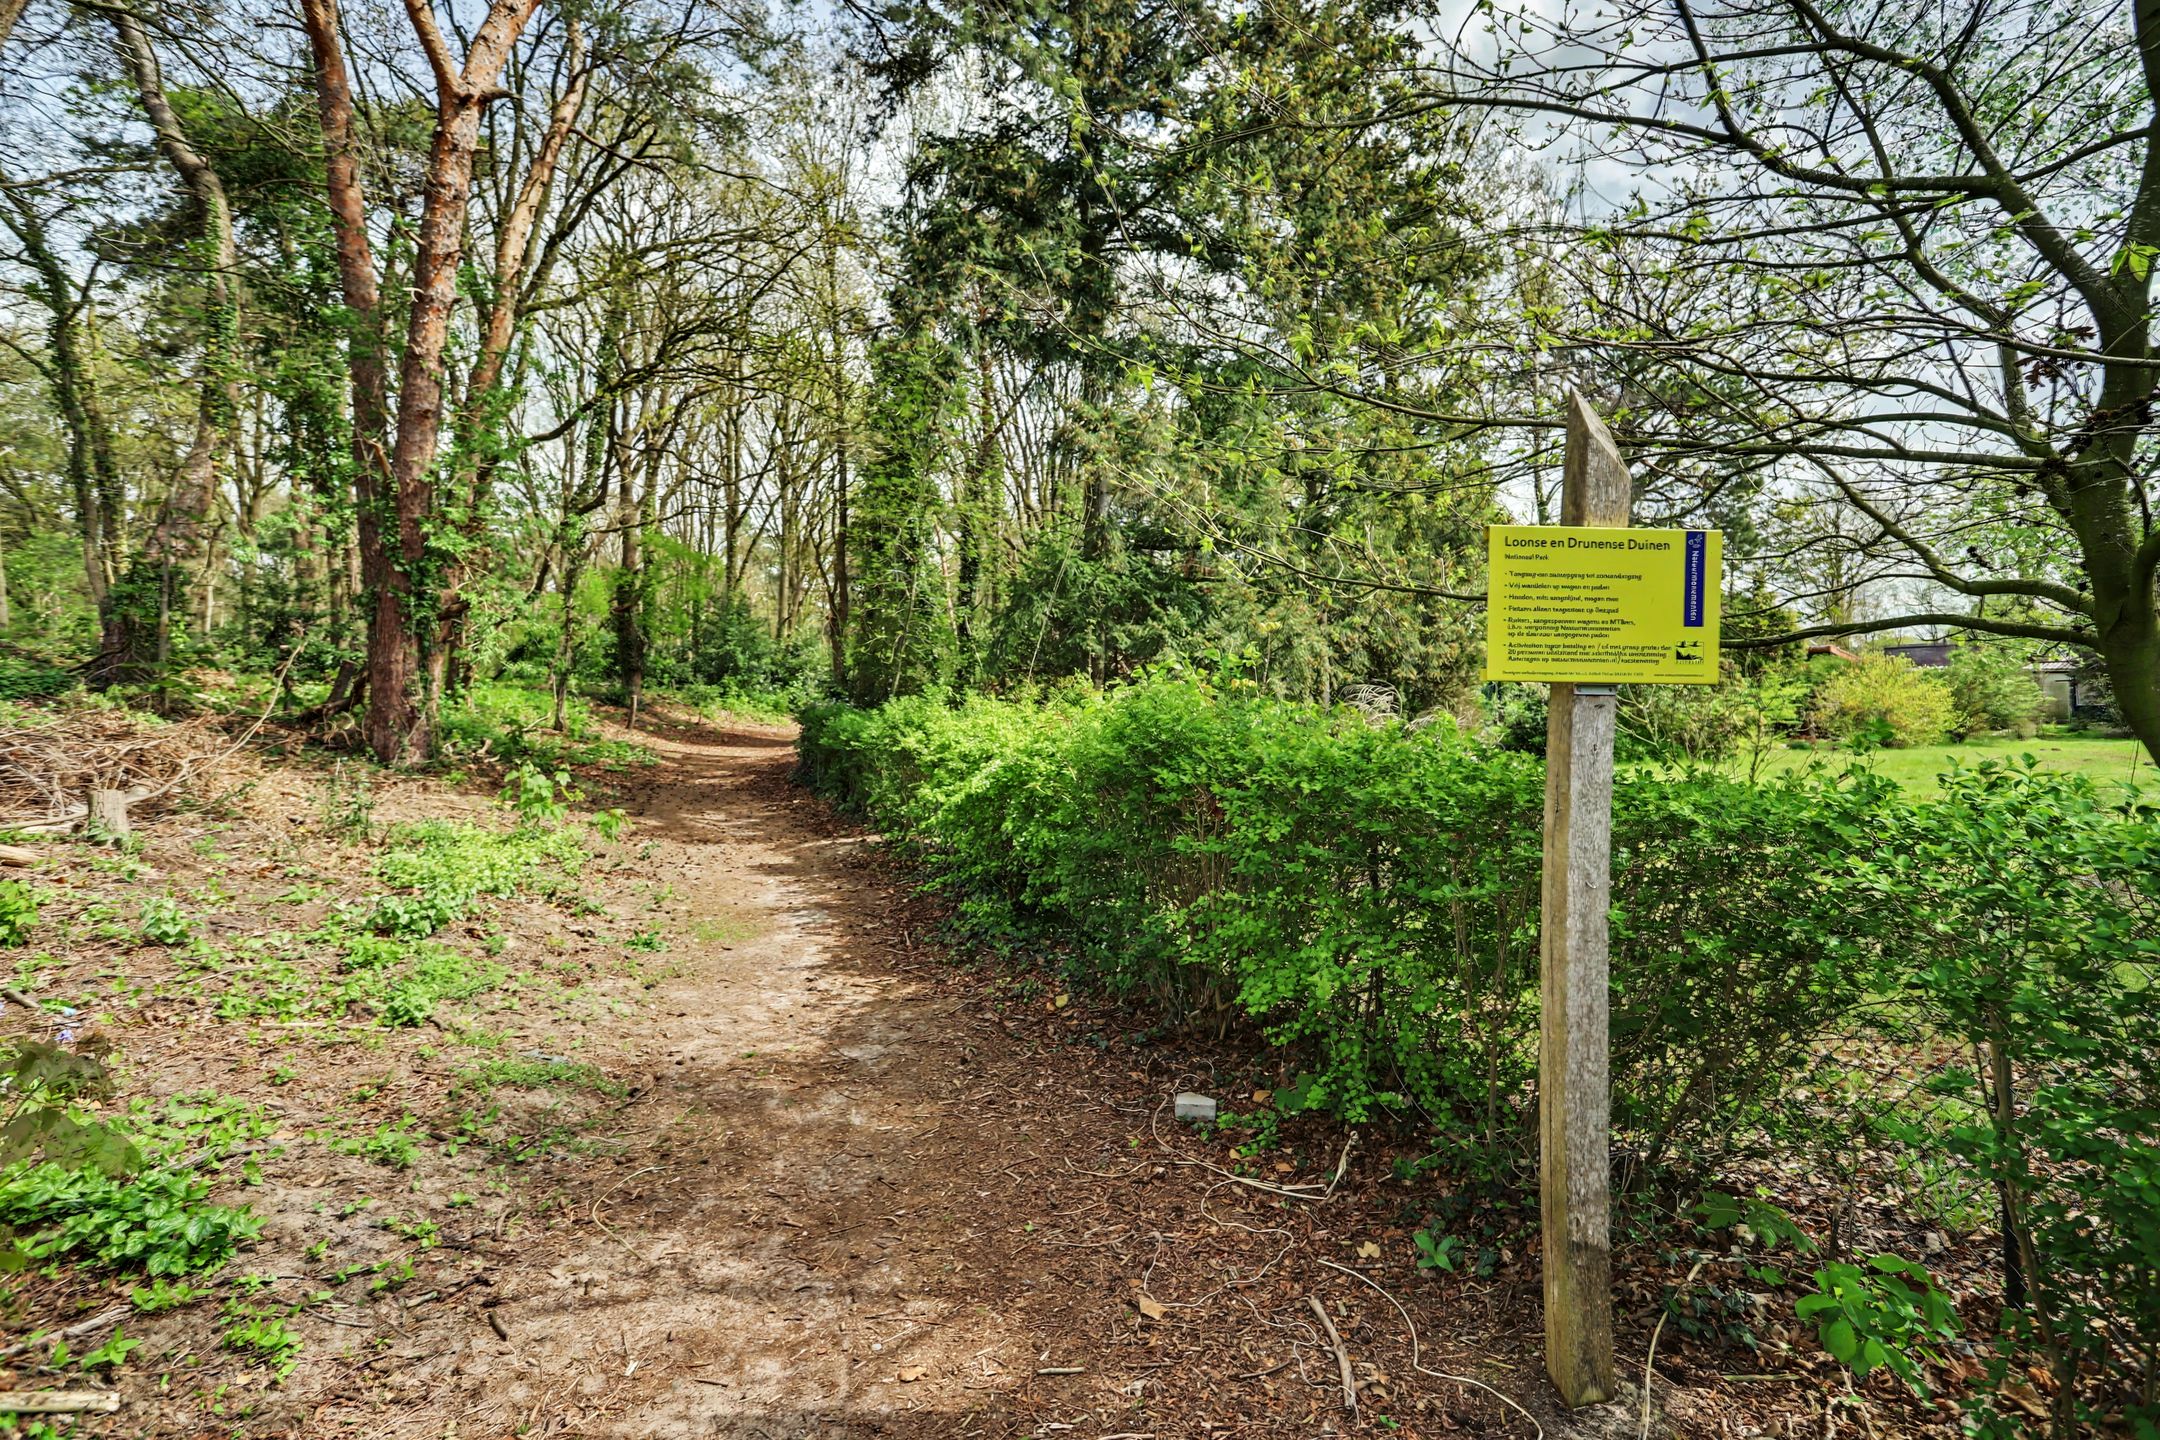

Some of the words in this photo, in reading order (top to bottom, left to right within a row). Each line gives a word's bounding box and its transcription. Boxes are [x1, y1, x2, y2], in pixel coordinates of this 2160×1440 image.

[1504, 536, 1547, 547] Loonse
[1550, 539, 1564, 548] en
[1568, 537, 1625, 550] Drunense
[1628, 539, 1670, 551] Duinen
